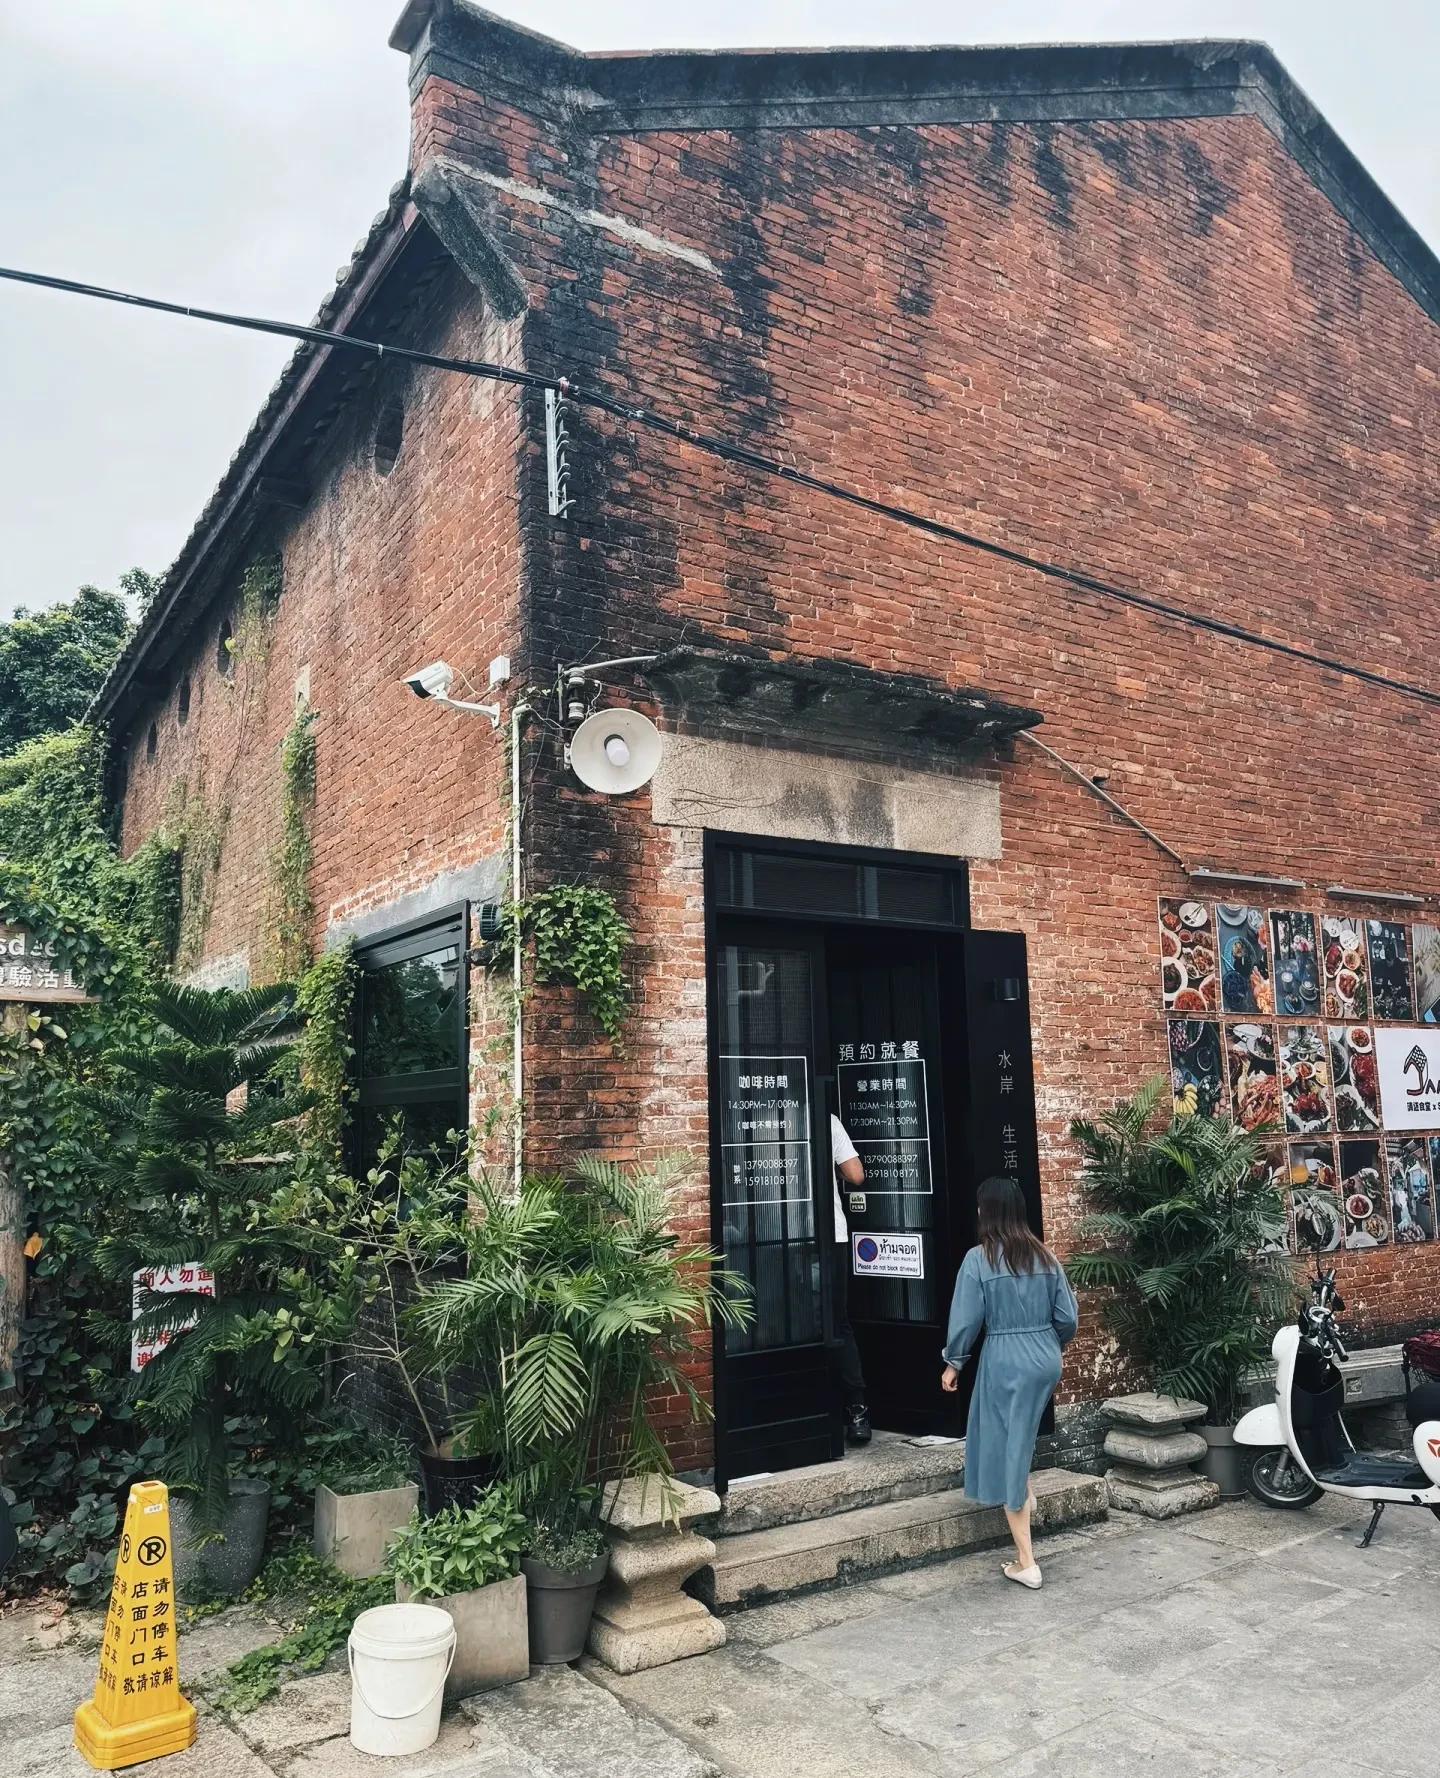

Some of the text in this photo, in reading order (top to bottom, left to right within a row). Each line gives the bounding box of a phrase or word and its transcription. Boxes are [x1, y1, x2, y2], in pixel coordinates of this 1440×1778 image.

[0, 965, 86, 989] 驗活動
[839, 1040, 920, 1061] 預約就餐
[738, 1075, 788, 1089] 咖啡時間
[857, 1077, 907, 1092] 營業時間
[744, 1158, 798, 1170] 13790088397
[864, 1154, 918, 1165] 13790088397
[744, 1174, 799, 1187] 15918108171
[151, 1577, 171, 1662] 请勿停车
[123, 1666, 174, 1696] 敬请谅解
